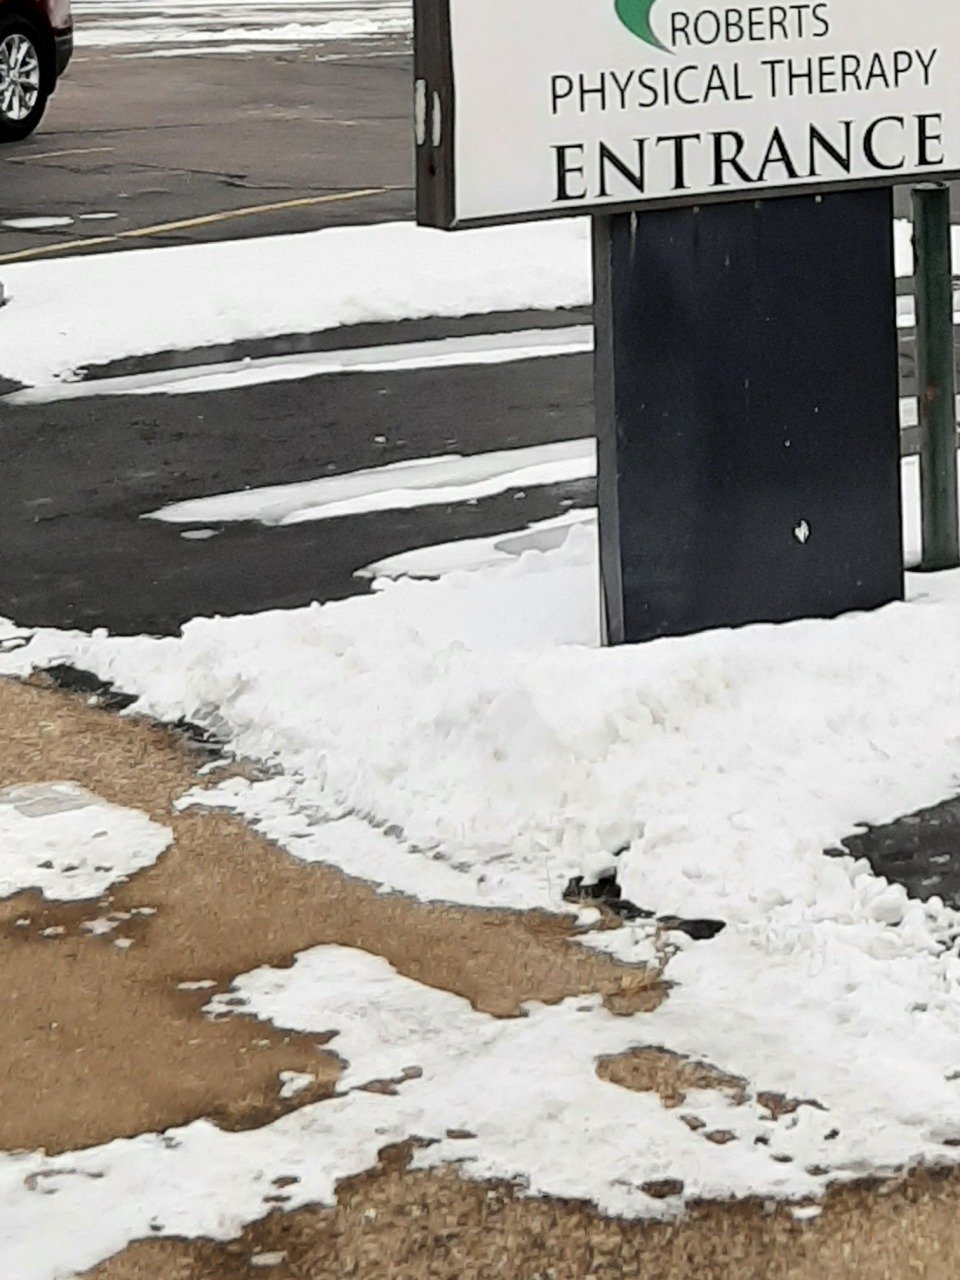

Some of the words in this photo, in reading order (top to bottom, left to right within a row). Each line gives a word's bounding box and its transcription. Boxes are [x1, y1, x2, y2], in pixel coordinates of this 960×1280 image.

[670, 3, 830, 47] ROBERTS
[550, 63, 752, 114] PHYSICAL
[761, 48, 938, 98] THERAPY
[551, 113, 945, 202] ENTRANCE
